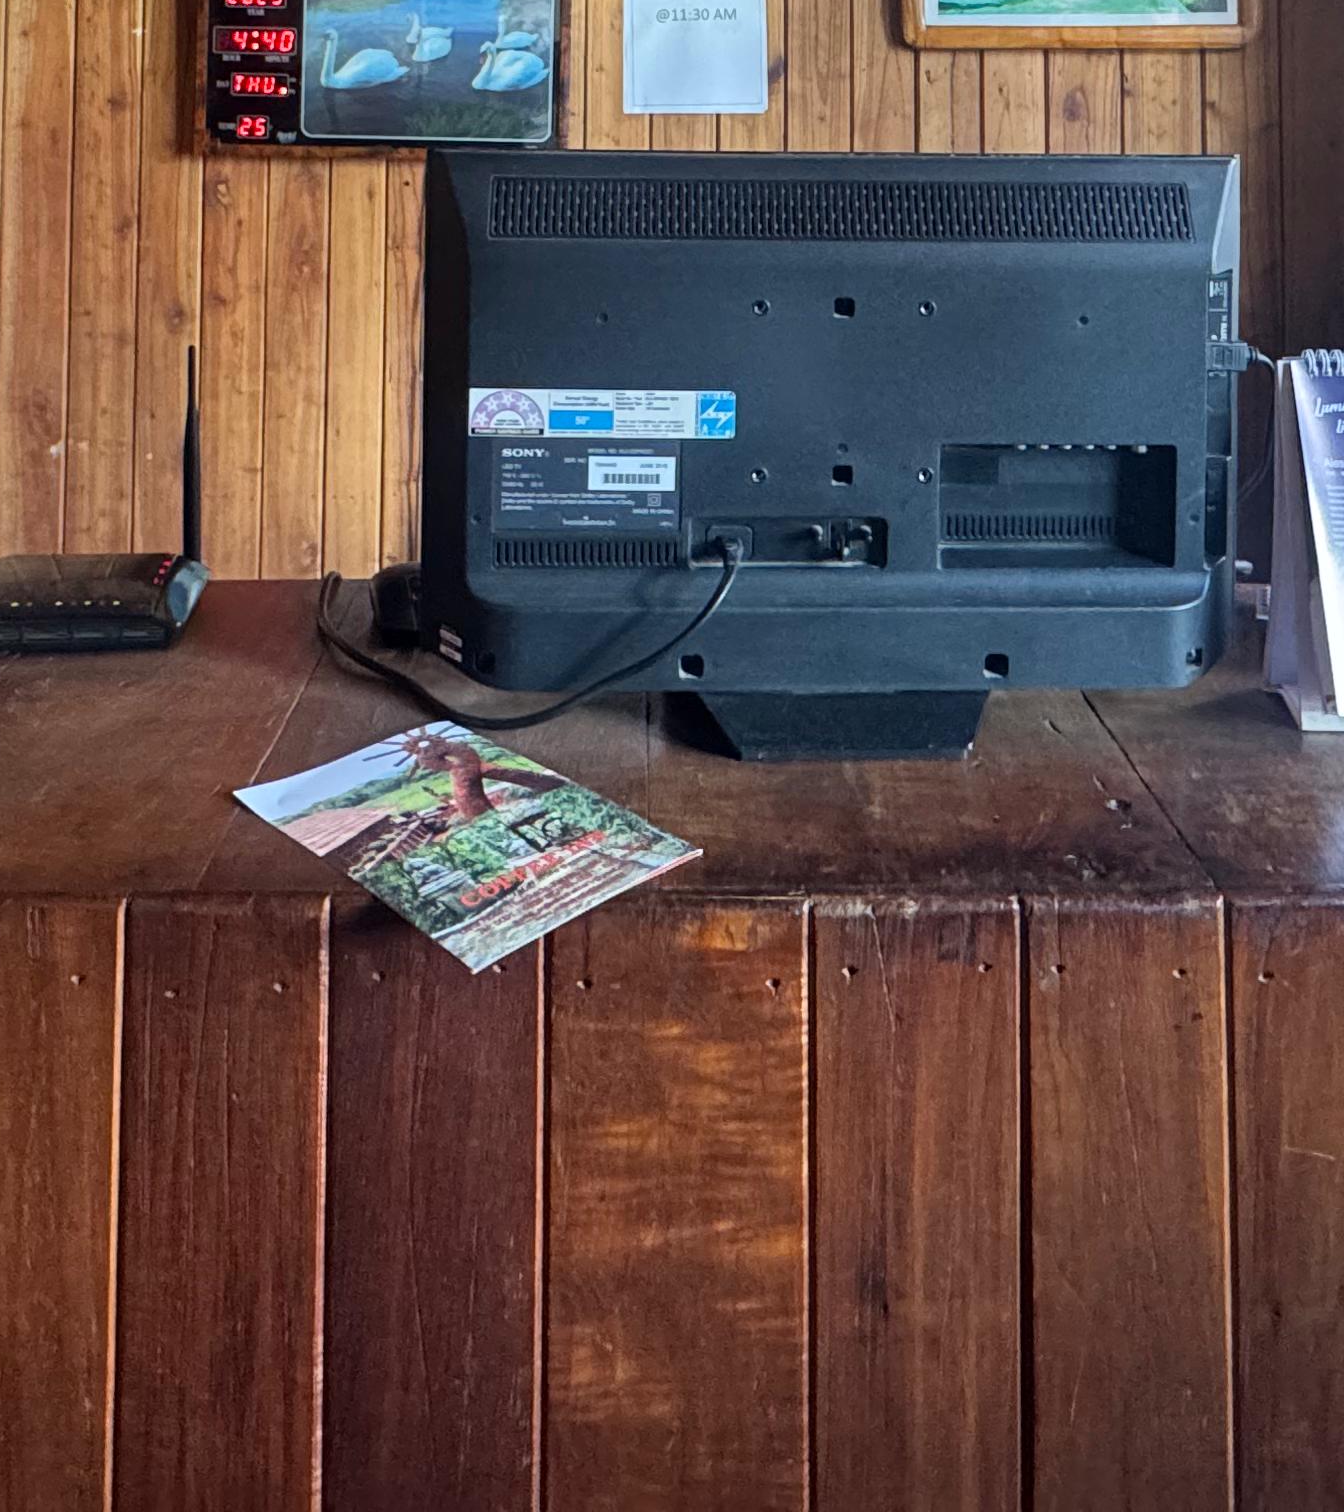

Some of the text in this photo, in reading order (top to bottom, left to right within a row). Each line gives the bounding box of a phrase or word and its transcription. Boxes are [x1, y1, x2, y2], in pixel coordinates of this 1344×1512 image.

[656, 8, 737, 23] @11:30 AM
[232, 30, 295, 53] 4:40
[238, 117, 267, 137] 25
[501, 448, 545, 458] SONY
